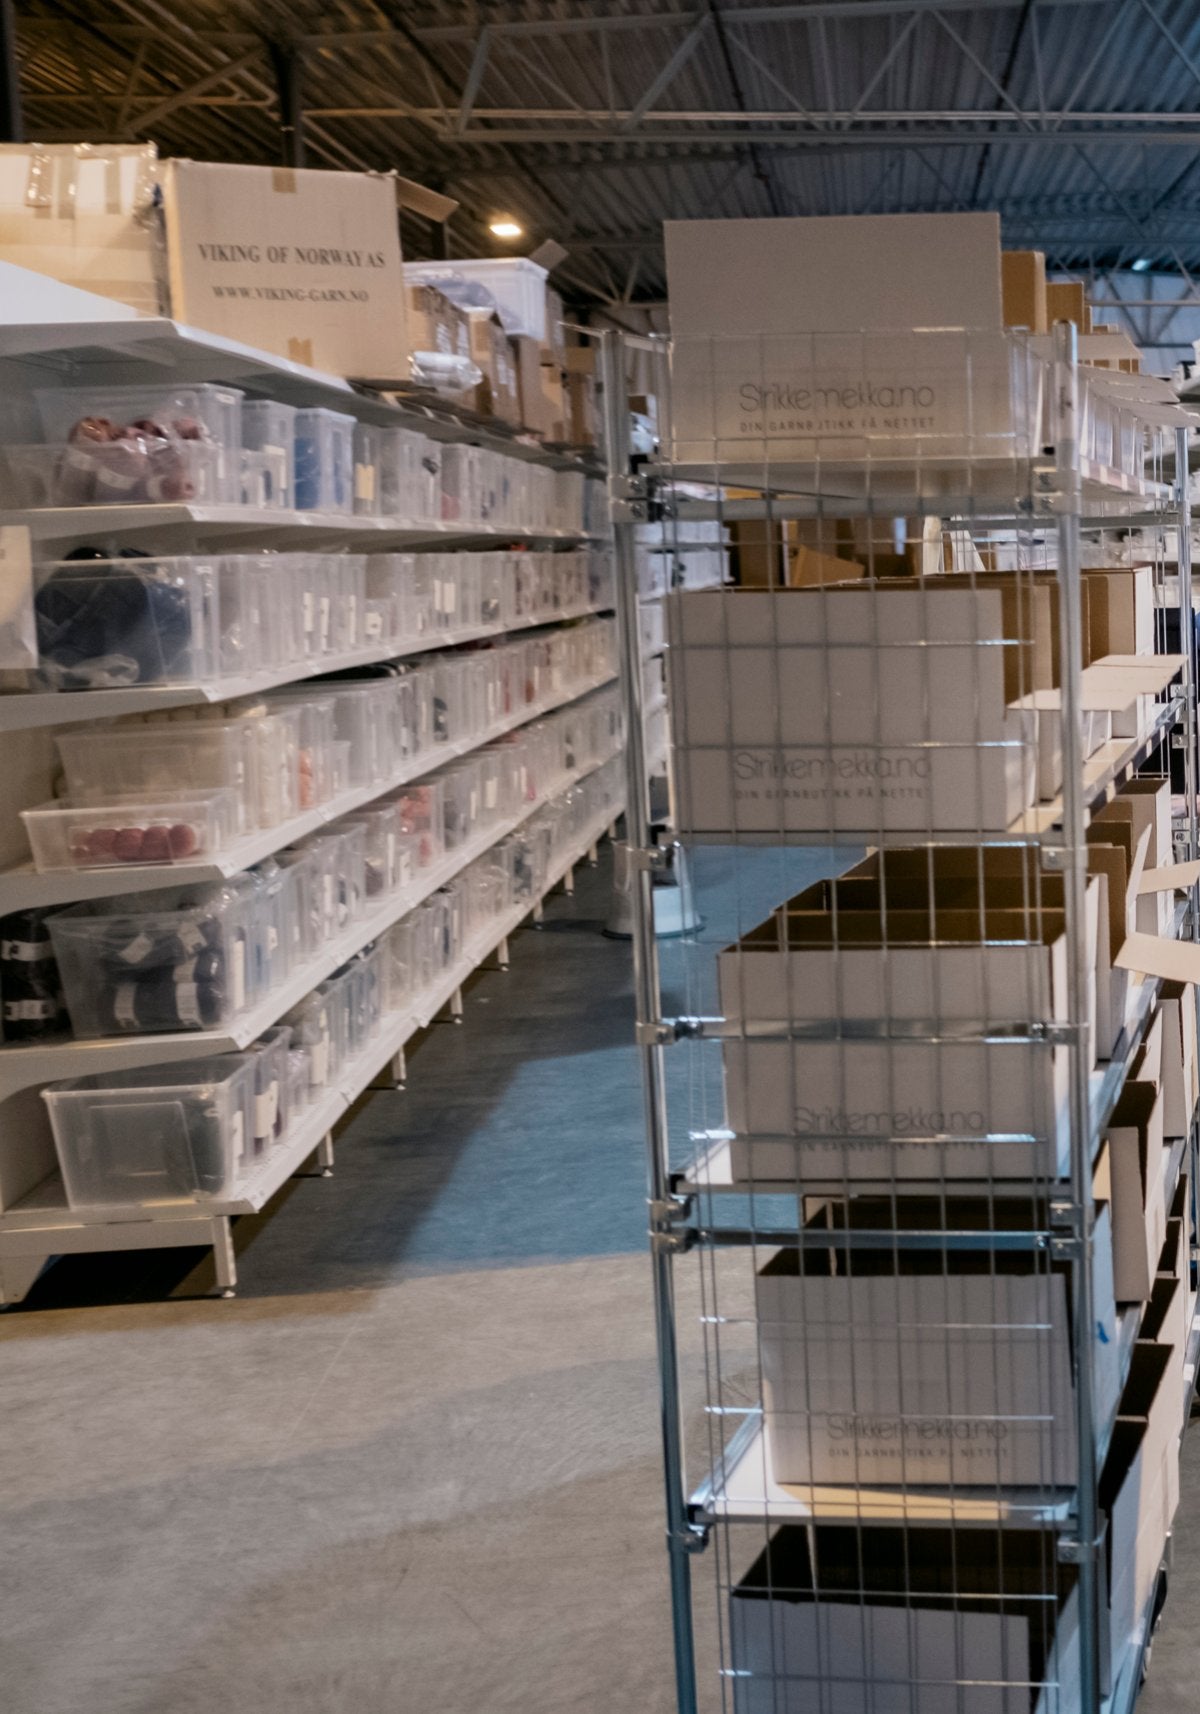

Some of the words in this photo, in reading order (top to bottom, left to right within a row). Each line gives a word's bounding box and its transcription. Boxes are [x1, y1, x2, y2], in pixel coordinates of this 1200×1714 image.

[198, 243, 261, 264] VIKING
[267, 246, 288, 263] OF
[294, 247, 362, 267] NORWAY
[366, 251, 386, 268] AS
[212, 286, 370, 302] WWW.VIKING-GARN.NO
[740, 422, 762, 433] DIN
[884, 416, 935, 429] NETTET
